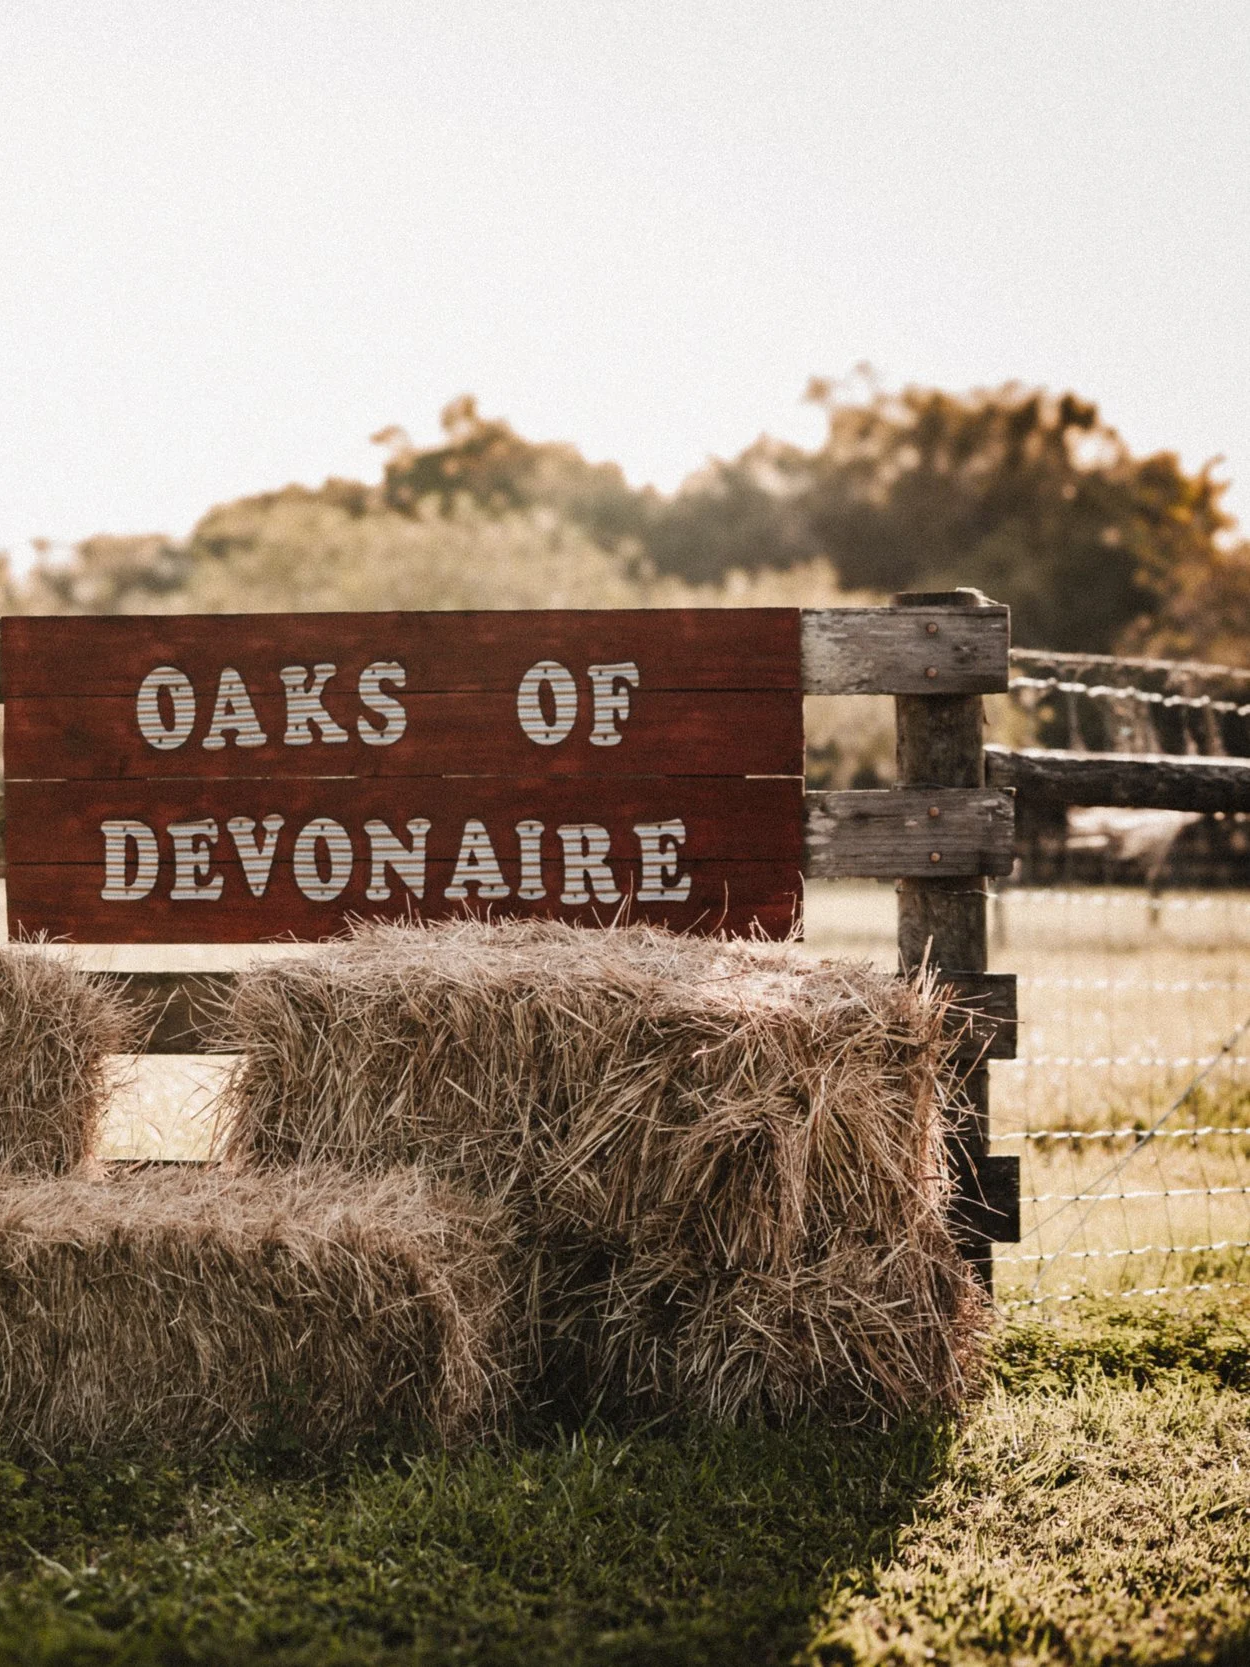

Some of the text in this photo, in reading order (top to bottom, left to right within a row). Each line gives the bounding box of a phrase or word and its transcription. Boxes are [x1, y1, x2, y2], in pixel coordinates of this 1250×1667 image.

[135, 659, 640, 751] OAKS OF
[99, 813, 692, 905] DEVONAIRE
